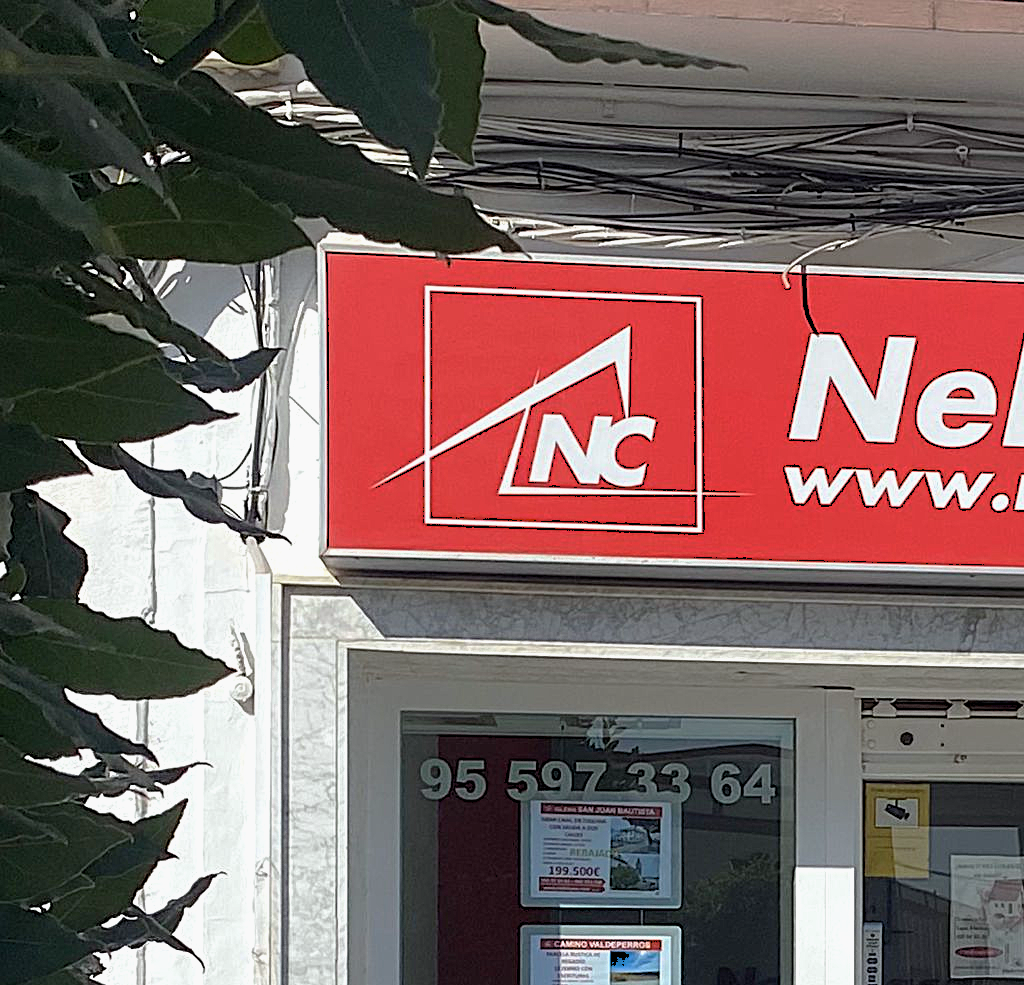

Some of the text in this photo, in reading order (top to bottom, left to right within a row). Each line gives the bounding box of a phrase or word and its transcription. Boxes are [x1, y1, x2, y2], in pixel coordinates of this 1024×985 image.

[528, 413, 657, 488] NC
[419, 758, 777, 805] 95 597 33 64
[554, 940, 588, 949] CAMINO
